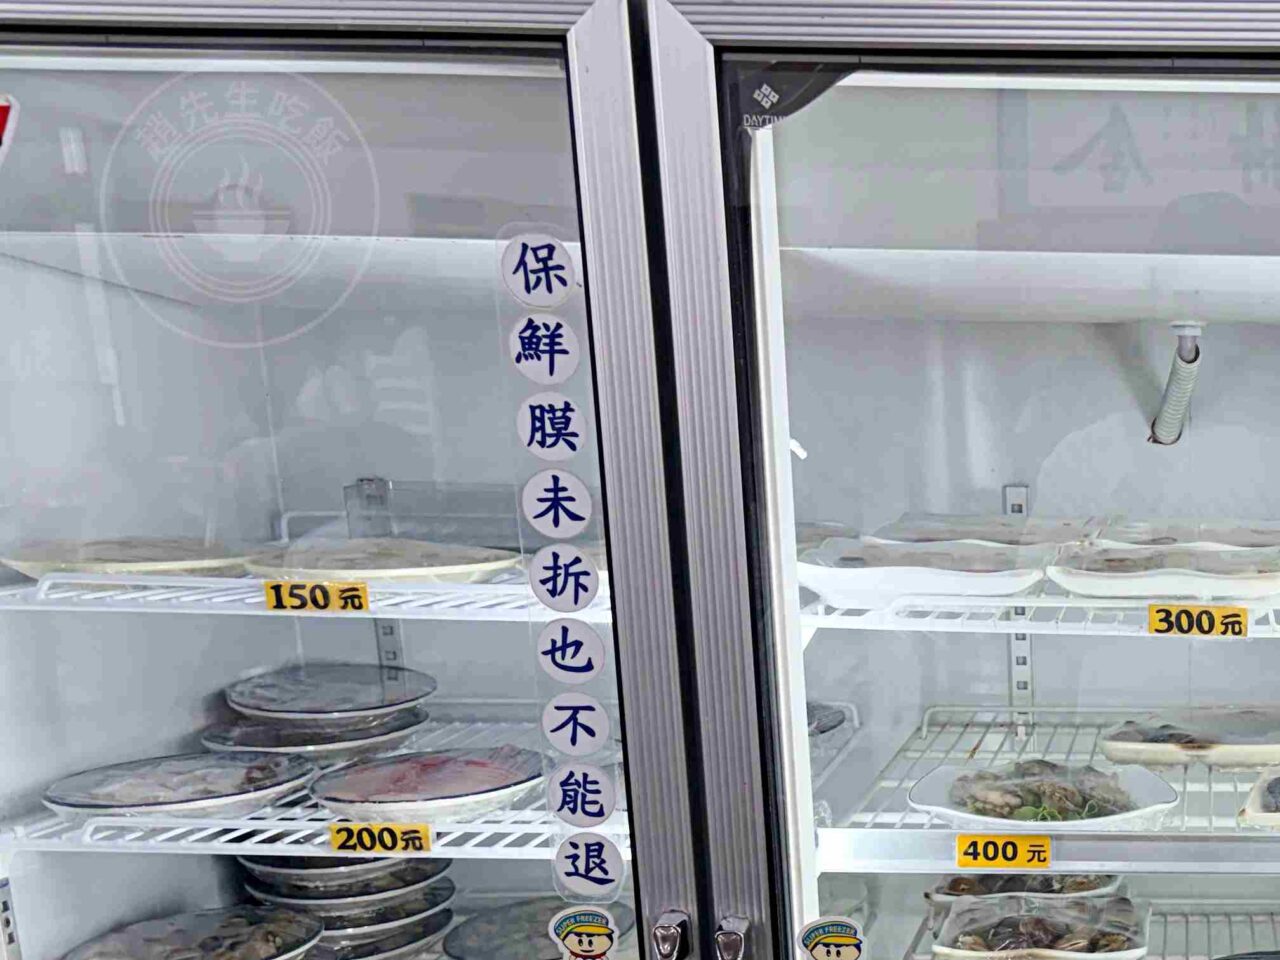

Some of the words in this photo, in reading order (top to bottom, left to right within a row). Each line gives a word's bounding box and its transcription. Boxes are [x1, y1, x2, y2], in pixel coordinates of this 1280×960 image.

[512, 242, 616, 886] 保鮮膜未拆也不能退
